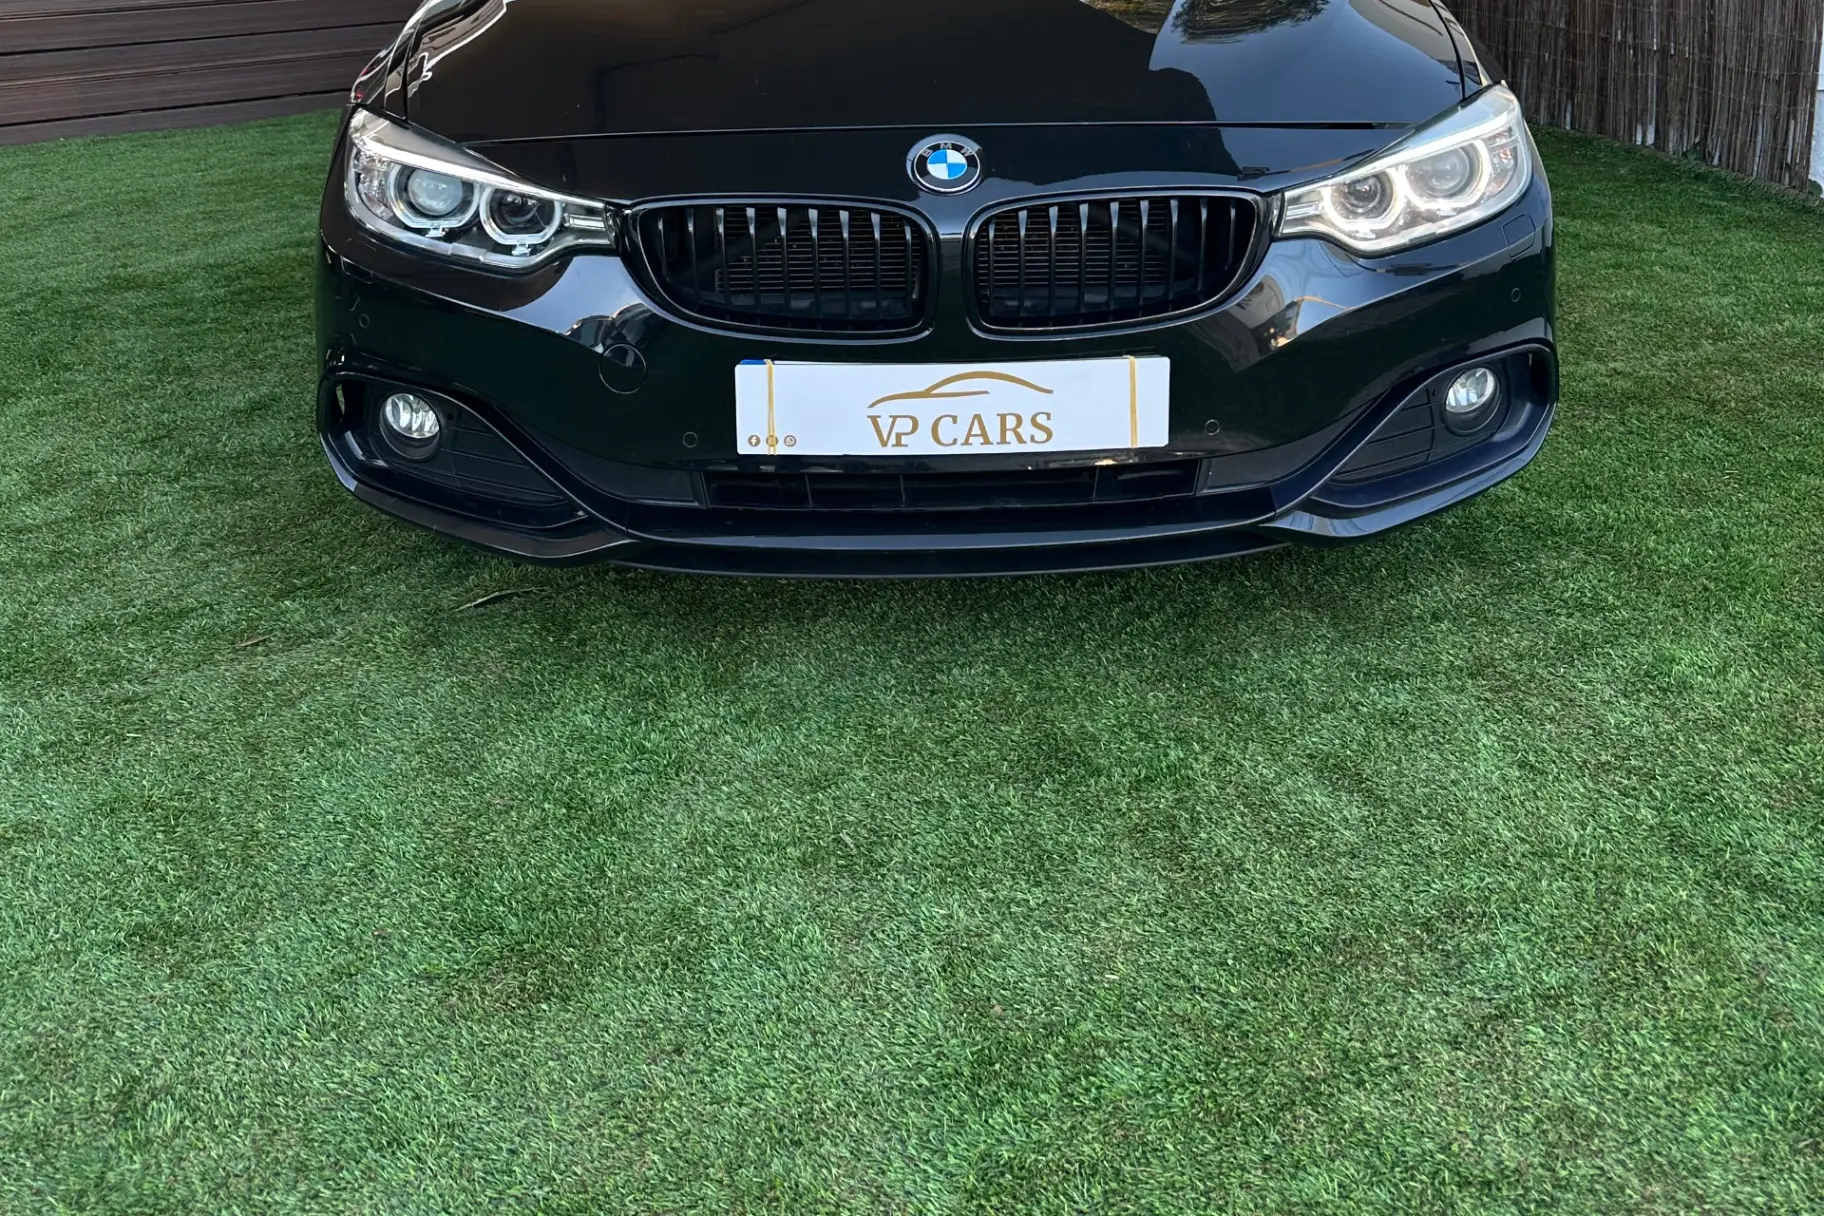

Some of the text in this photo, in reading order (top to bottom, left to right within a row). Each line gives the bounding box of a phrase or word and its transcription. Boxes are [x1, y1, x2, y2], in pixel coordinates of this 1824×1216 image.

[920, 142, 974, 158] BMW
[867, 410, 1055, 448] VP CARS
